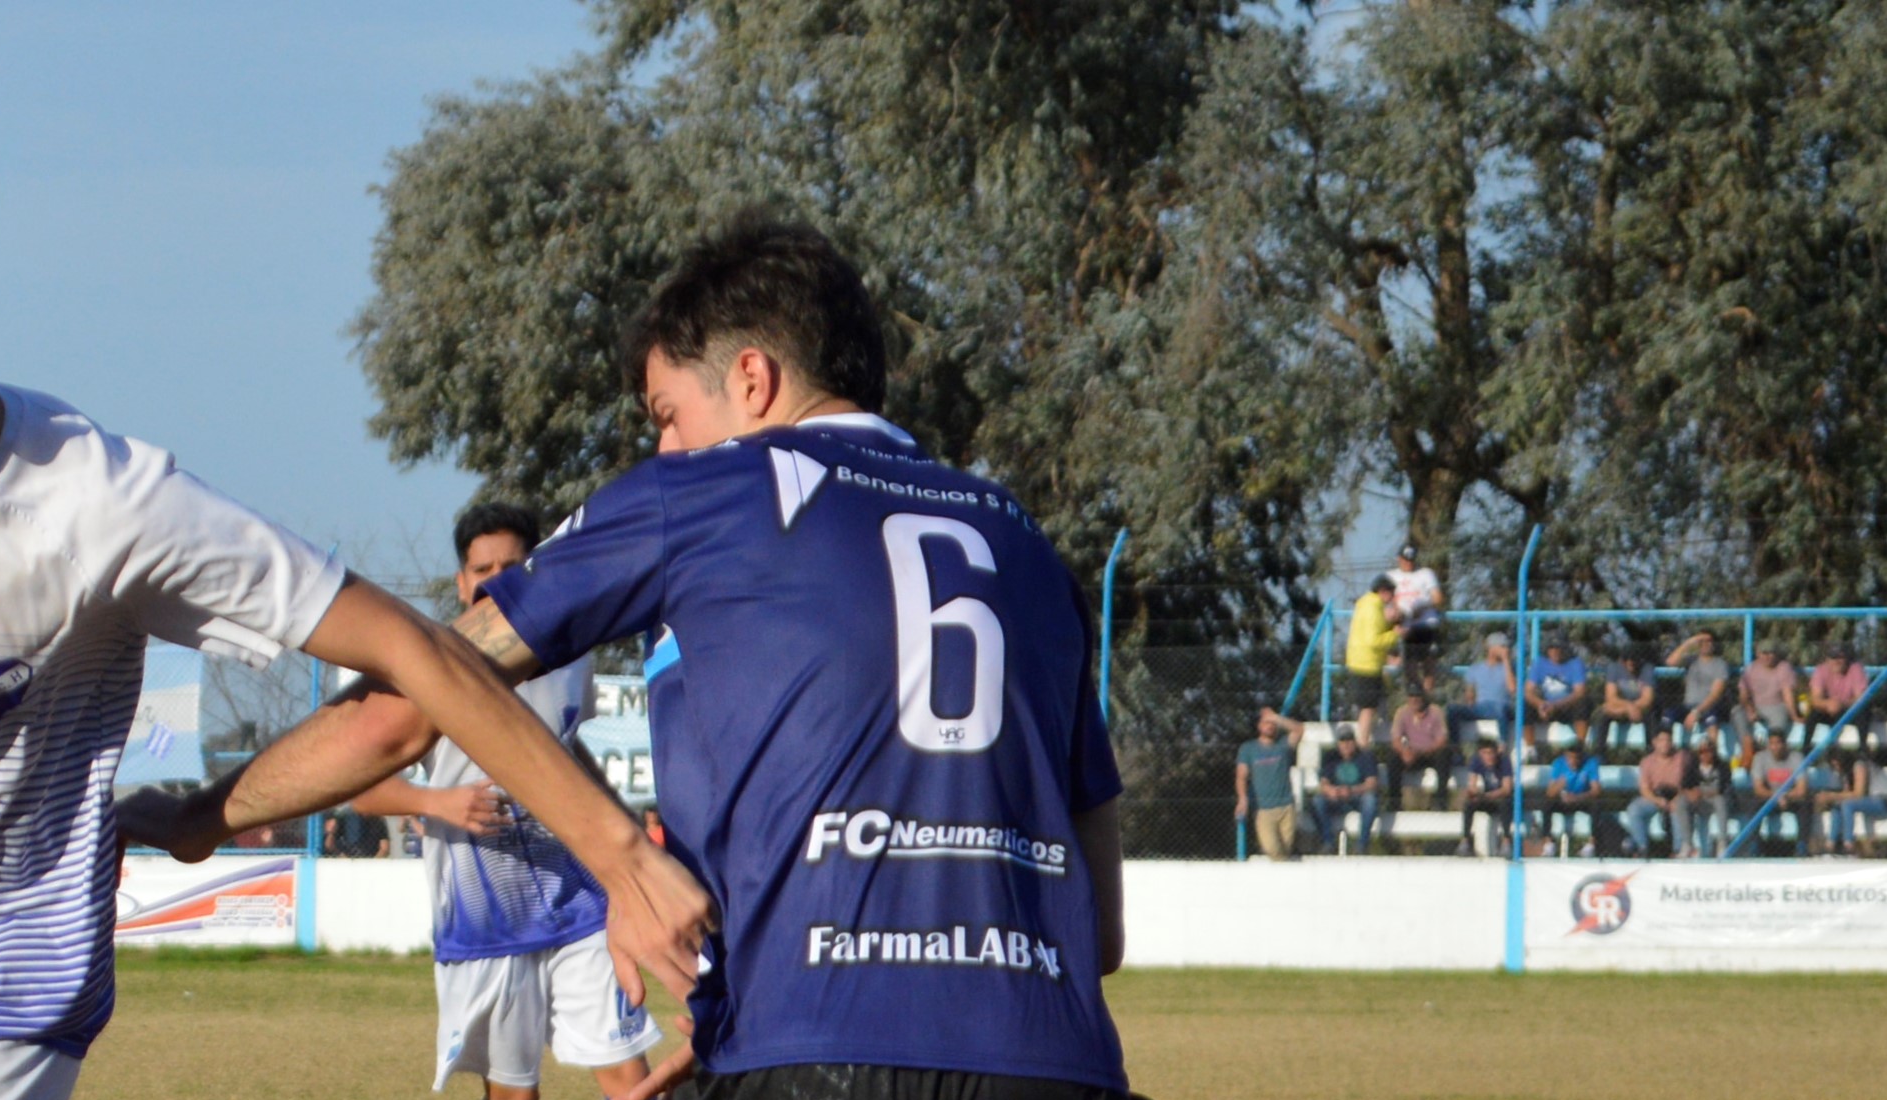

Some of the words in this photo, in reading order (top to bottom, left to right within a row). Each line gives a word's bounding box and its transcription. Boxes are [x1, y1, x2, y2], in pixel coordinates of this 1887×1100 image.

[836, 465, 979, 504] Beneficios
[882, 513, 1005, 751] 6
[1660, 881, 1774, 904] Materiales
[808, 925, 1033, 968] FarmaLAB
